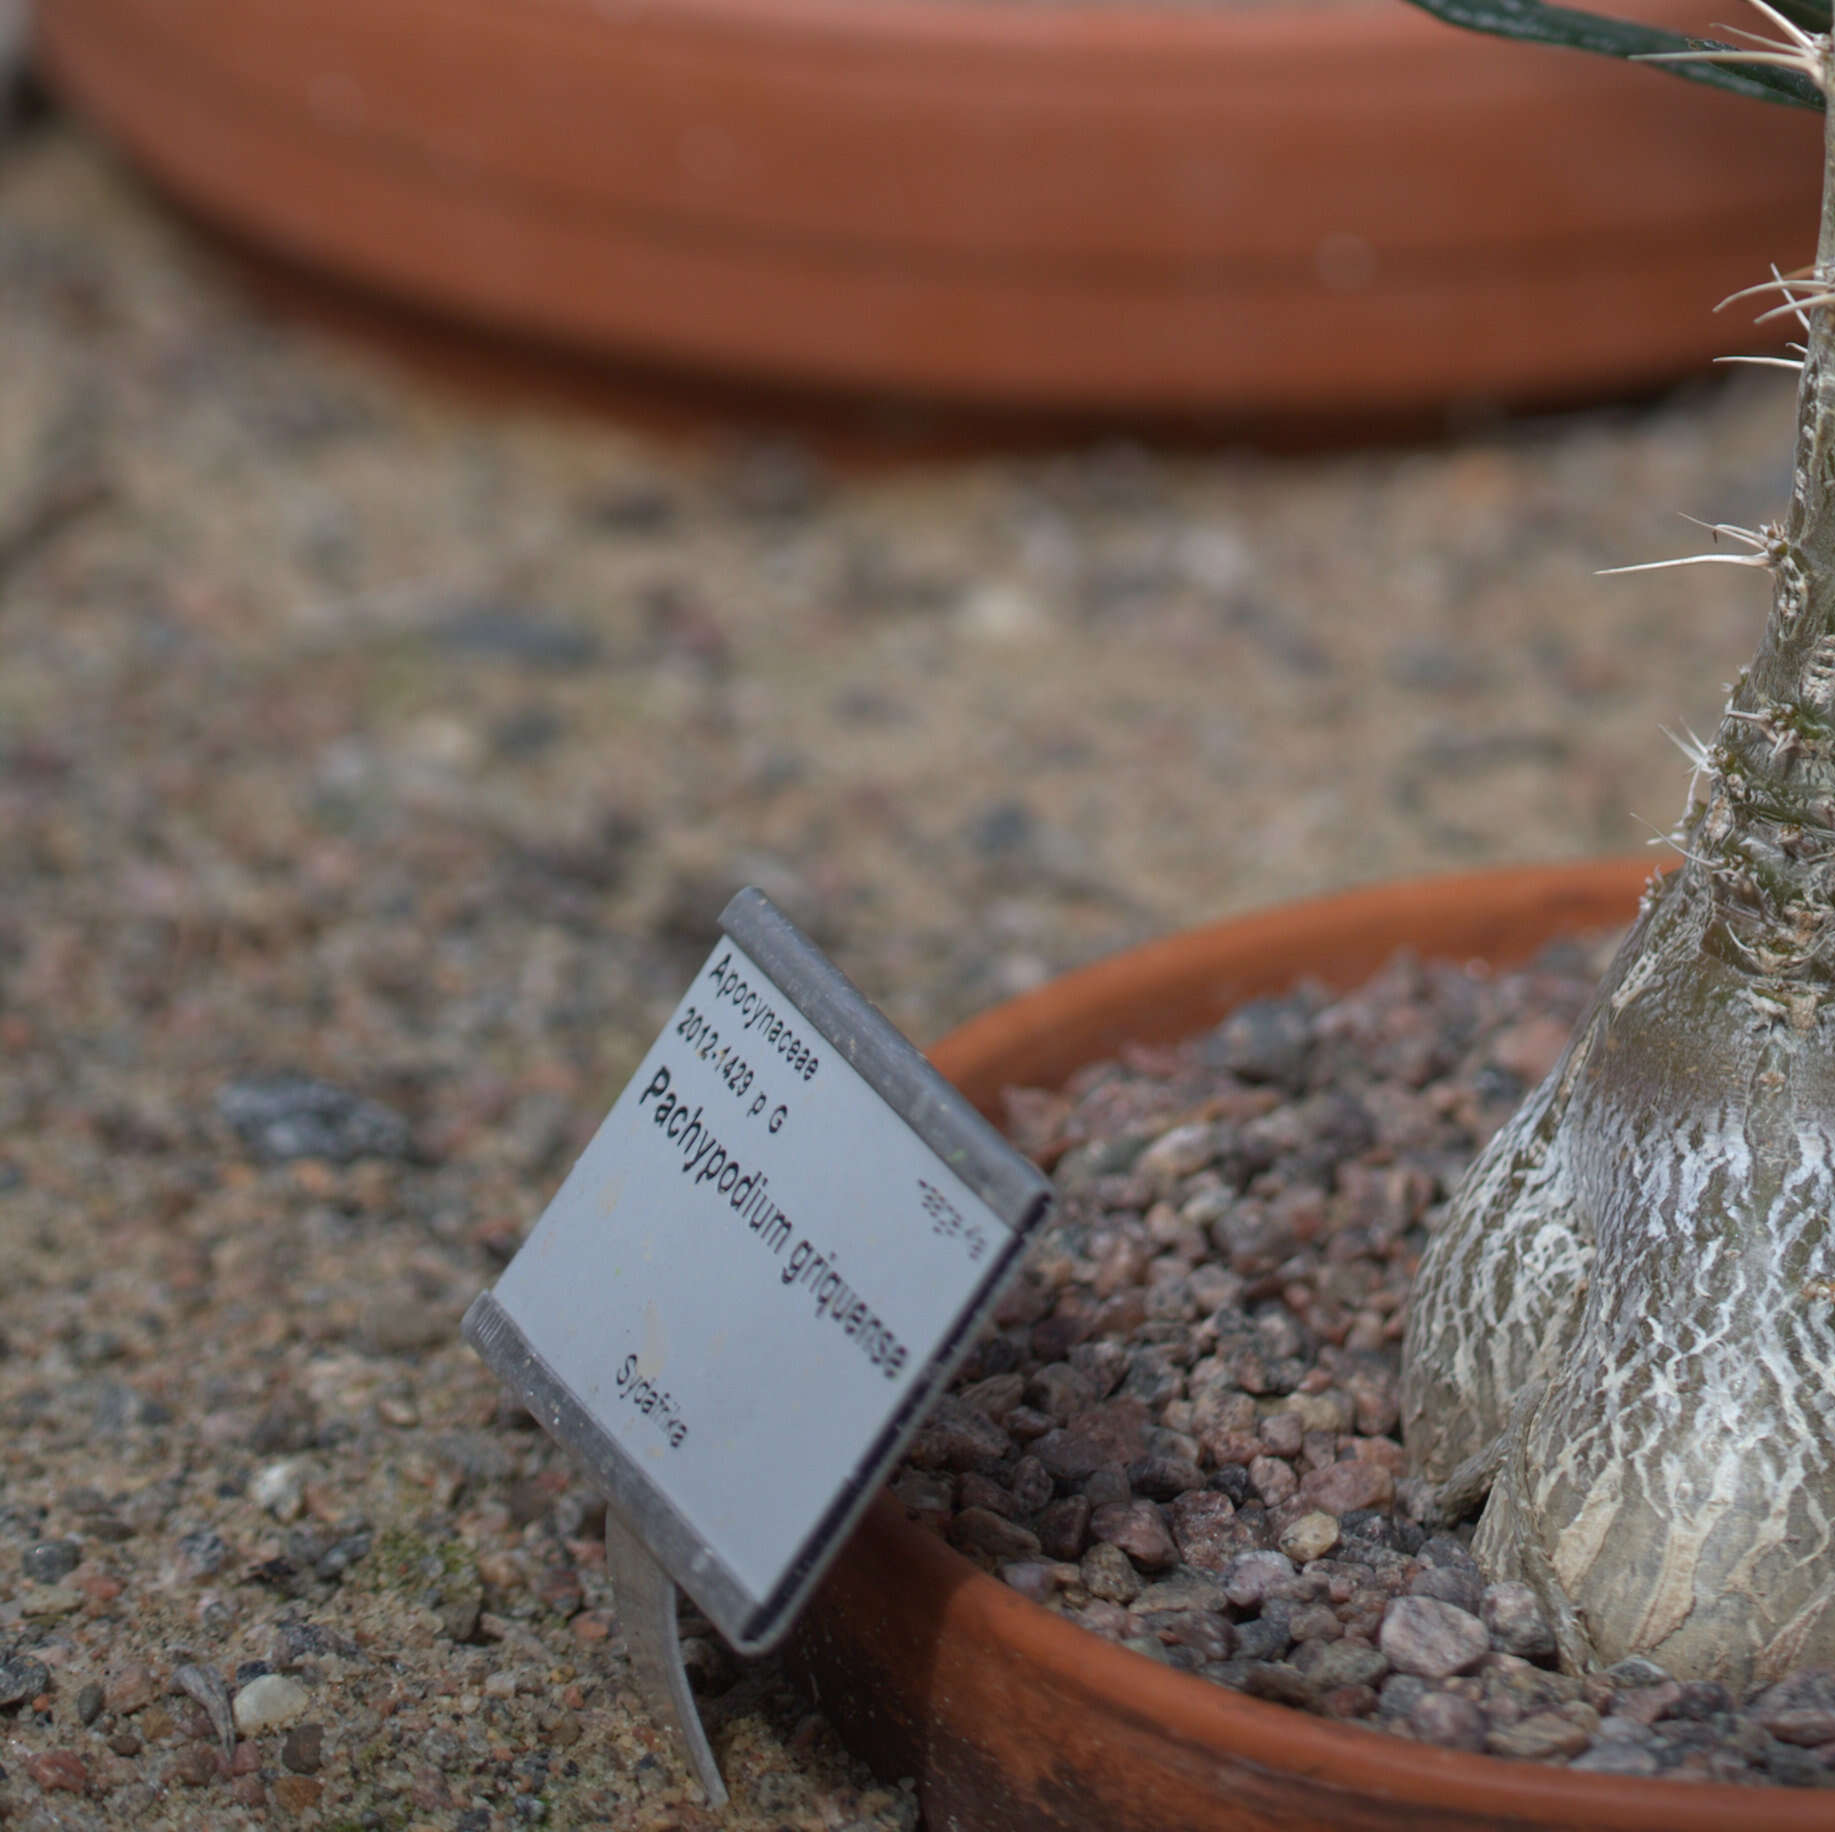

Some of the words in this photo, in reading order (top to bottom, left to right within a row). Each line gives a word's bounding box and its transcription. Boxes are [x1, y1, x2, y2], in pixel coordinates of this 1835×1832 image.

[676, 1006, 754, 1097] 2012-1429
[747, 1091, 767, 1116] p
[768, 1104, 789, 1135] G
[708, 953, 819, 1083] Apocynaceae
[638, 1065, 793, 1254] Pachypodium
[780, 1240, 910, 1381] griquense
[614, 1353, 688, 1449] Sydafrika
